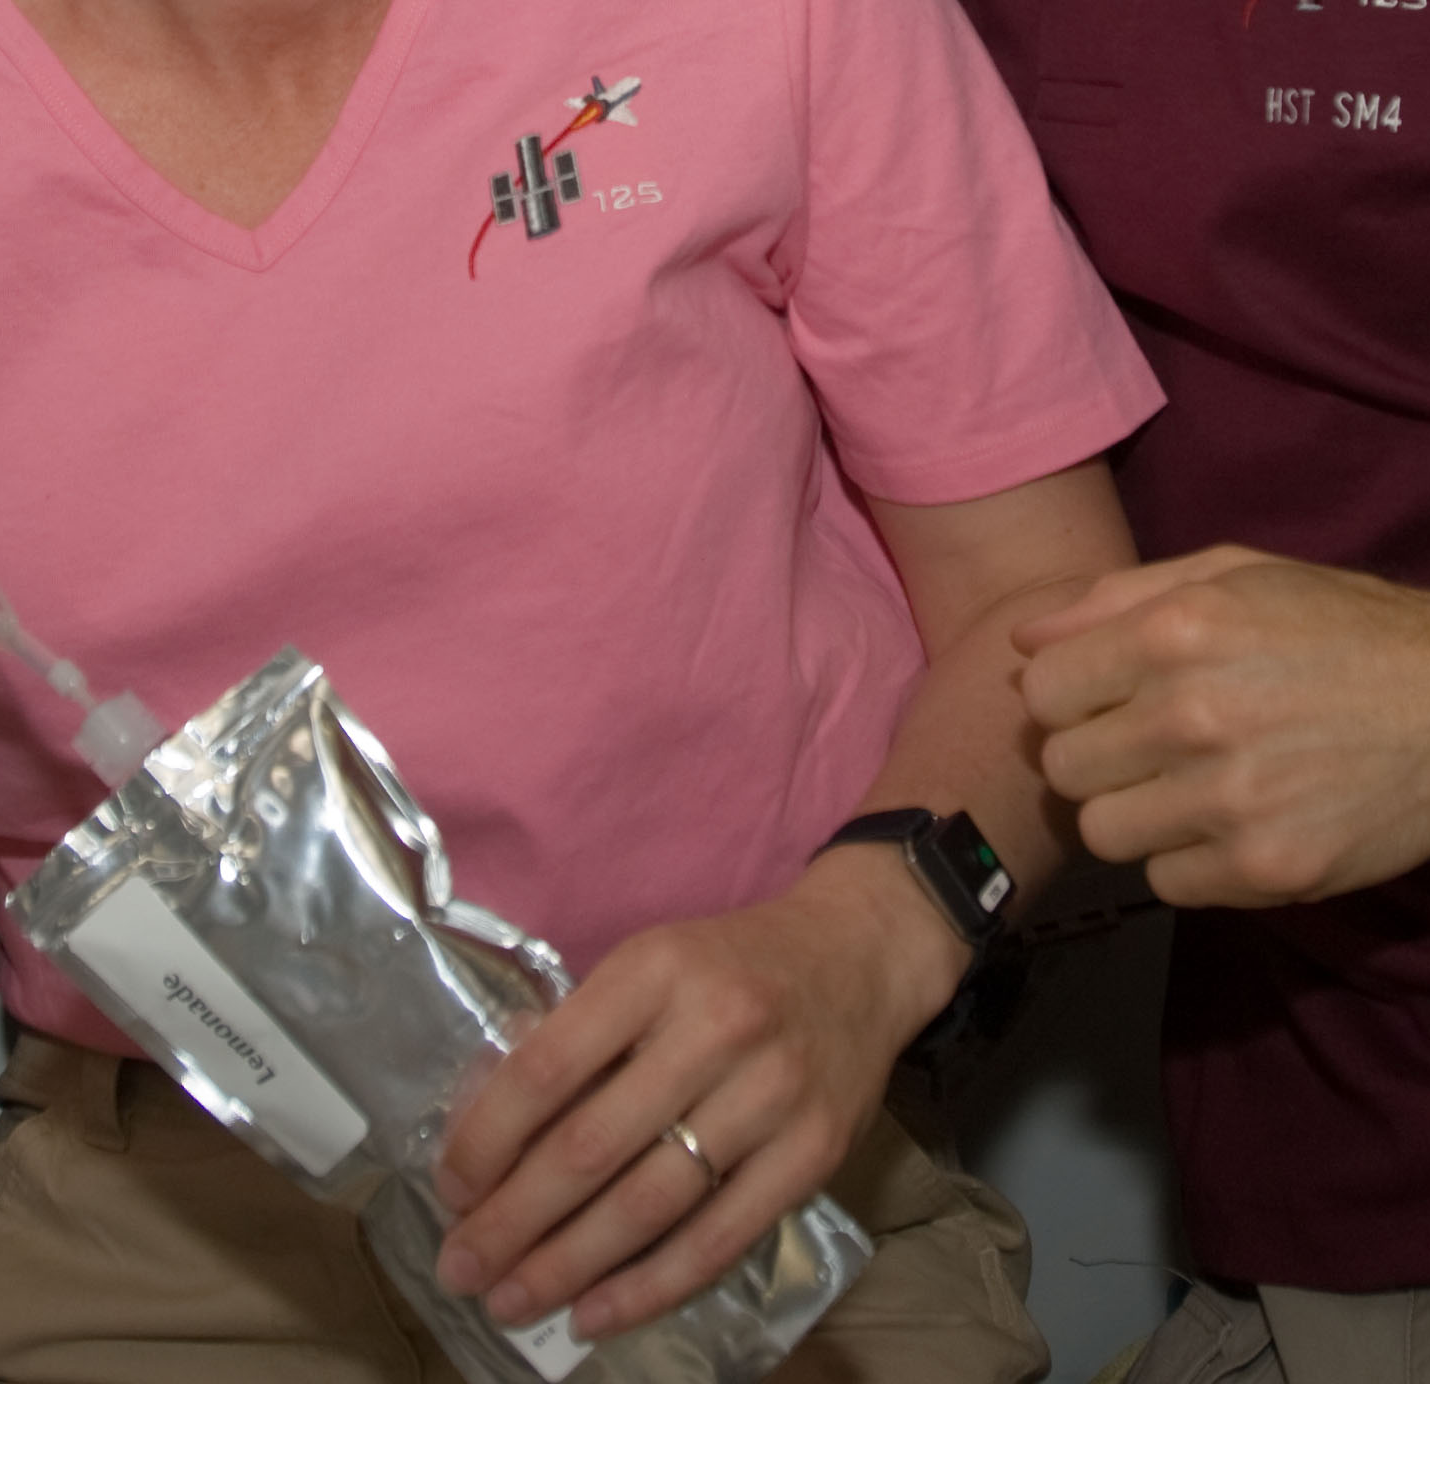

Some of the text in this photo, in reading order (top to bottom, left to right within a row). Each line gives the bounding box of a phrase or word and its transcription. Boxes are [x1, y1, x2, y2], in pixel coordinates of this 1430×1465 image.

[1265, 87, 1403, 134] HST SM4
[592, 181, 663, 213] 125
[163, 973, 276, 1086] Lemonade
